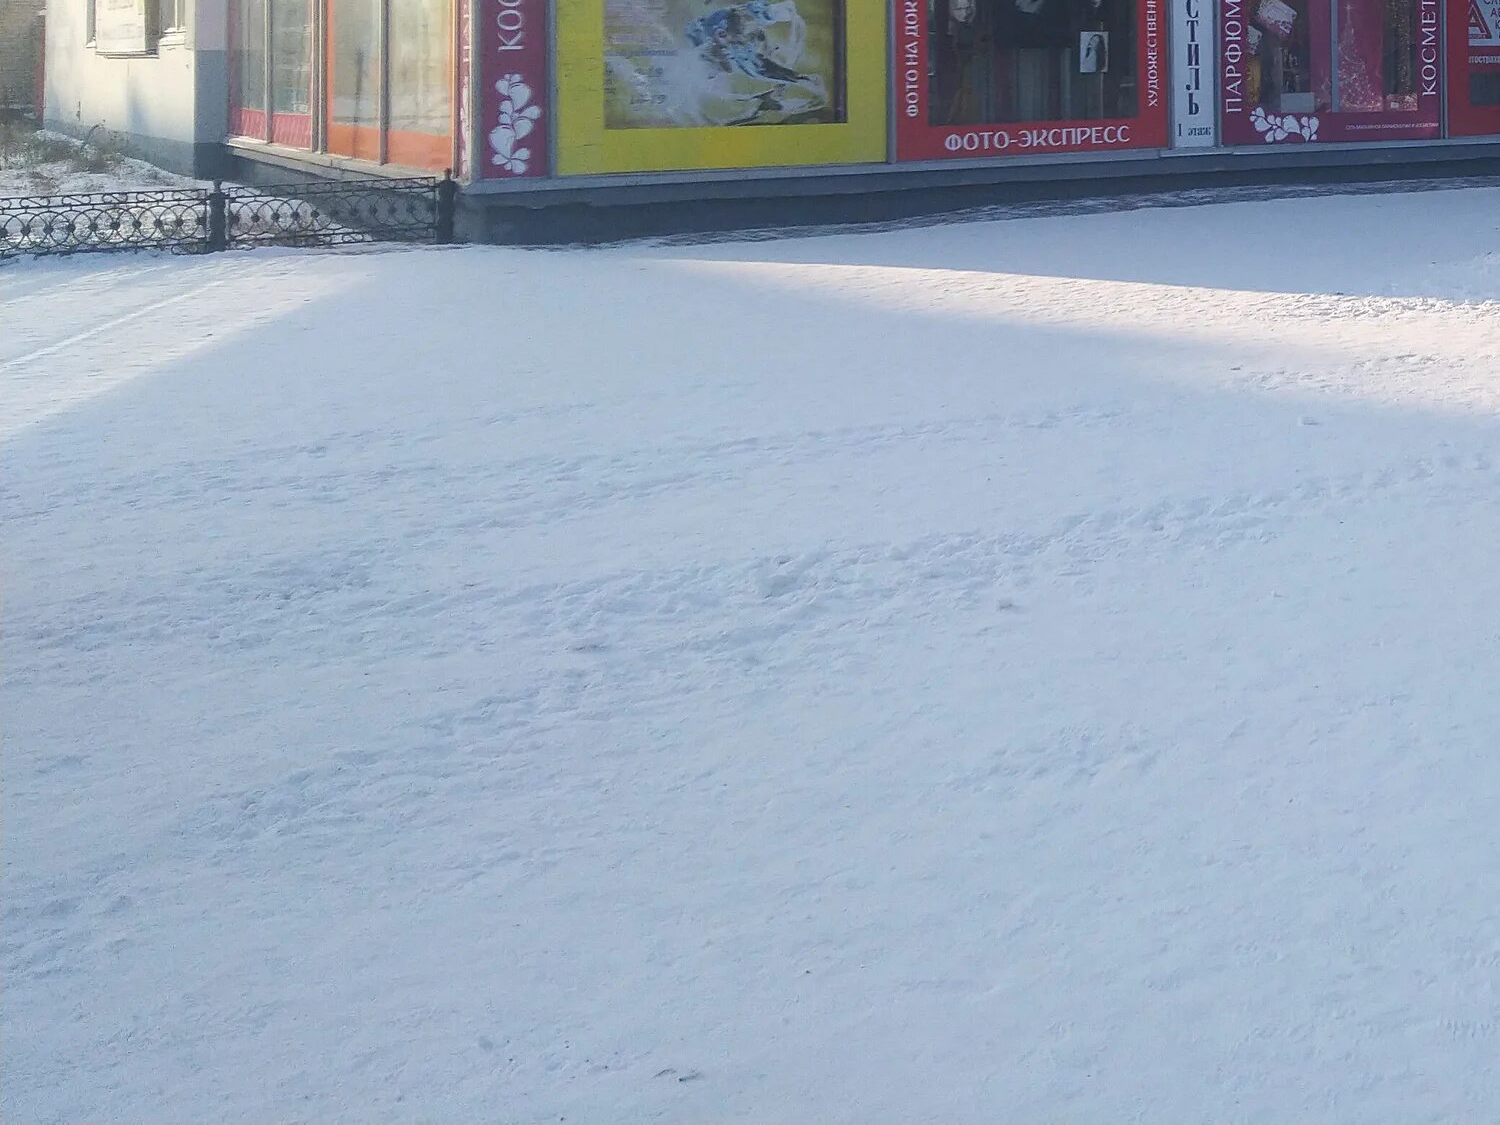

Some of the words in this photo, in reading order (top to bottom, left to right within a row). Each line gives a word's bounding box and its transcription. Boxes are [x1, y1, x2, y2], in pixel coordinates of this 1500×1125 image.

[903, 40, 918, 71] НА
[903, 75, 919, 118] ФОТО
[945, 125, 1130, 151] ФОТО-ЭКСПРЕСС
[1177, 124, 1183, 137] 1
